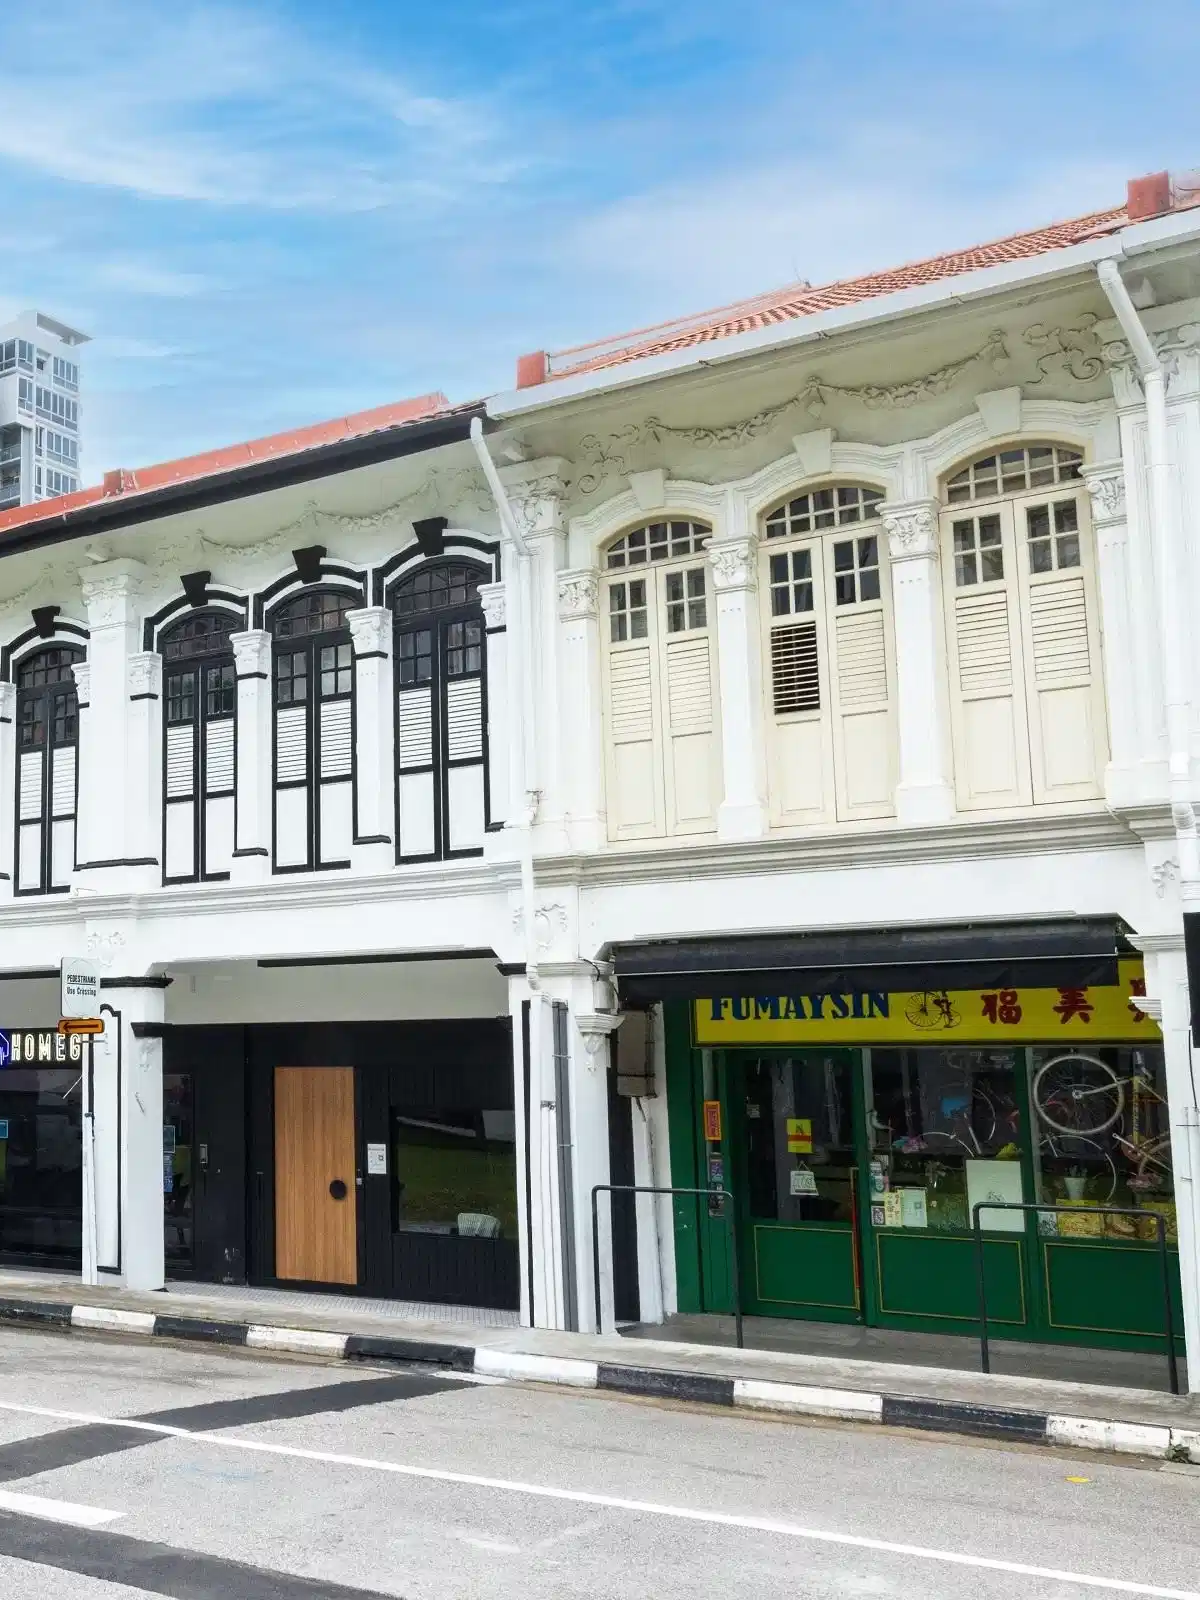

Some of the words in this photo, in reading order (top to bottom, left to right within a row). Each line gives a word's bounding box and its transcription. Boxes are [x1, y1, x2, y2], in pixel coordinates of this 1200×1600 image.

[67, 974, 96, 984] PEDESTRIANS
[66, 986, 76, 995] Use
[77, 987, 97, 997] Crossing
[710, 992, 889, 1021] FUMAYSIN
